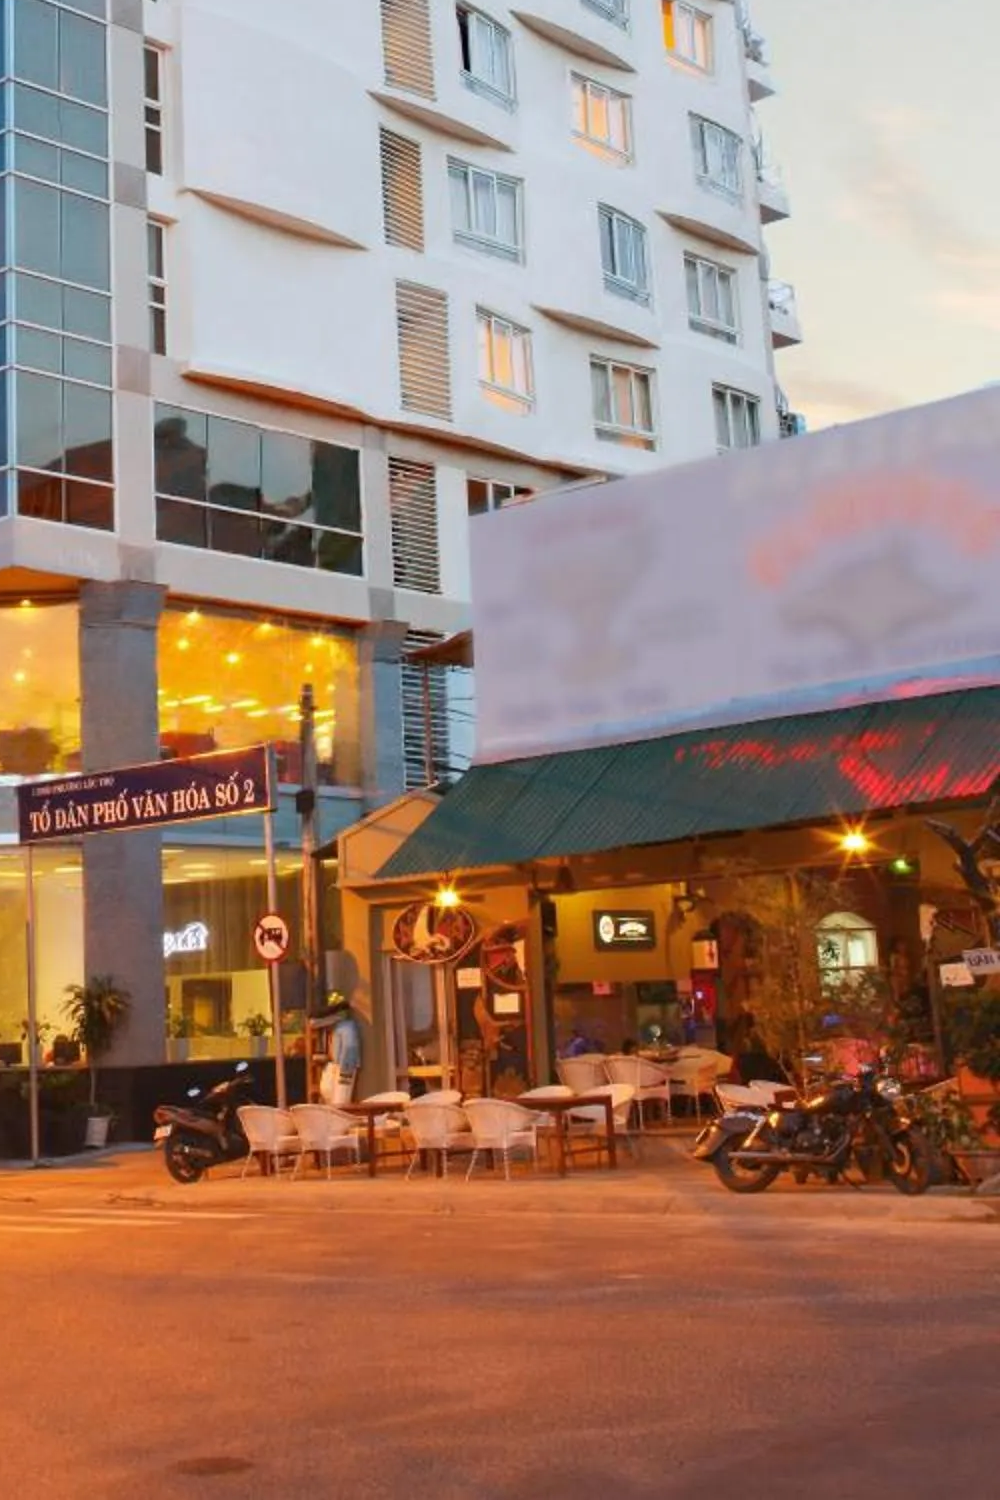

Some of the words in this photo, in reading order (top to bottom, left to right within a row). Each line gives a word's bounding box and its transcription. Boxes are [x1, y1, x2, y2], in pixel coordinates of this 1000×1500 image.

[92, 787, 128, 825] PHỐ
[131, 788, 168, 819] VĂN
[172, 780, 211, 813] HÓA
[215, 771, 239, 807] SỐ
[243, 779, 255, 804] 2
